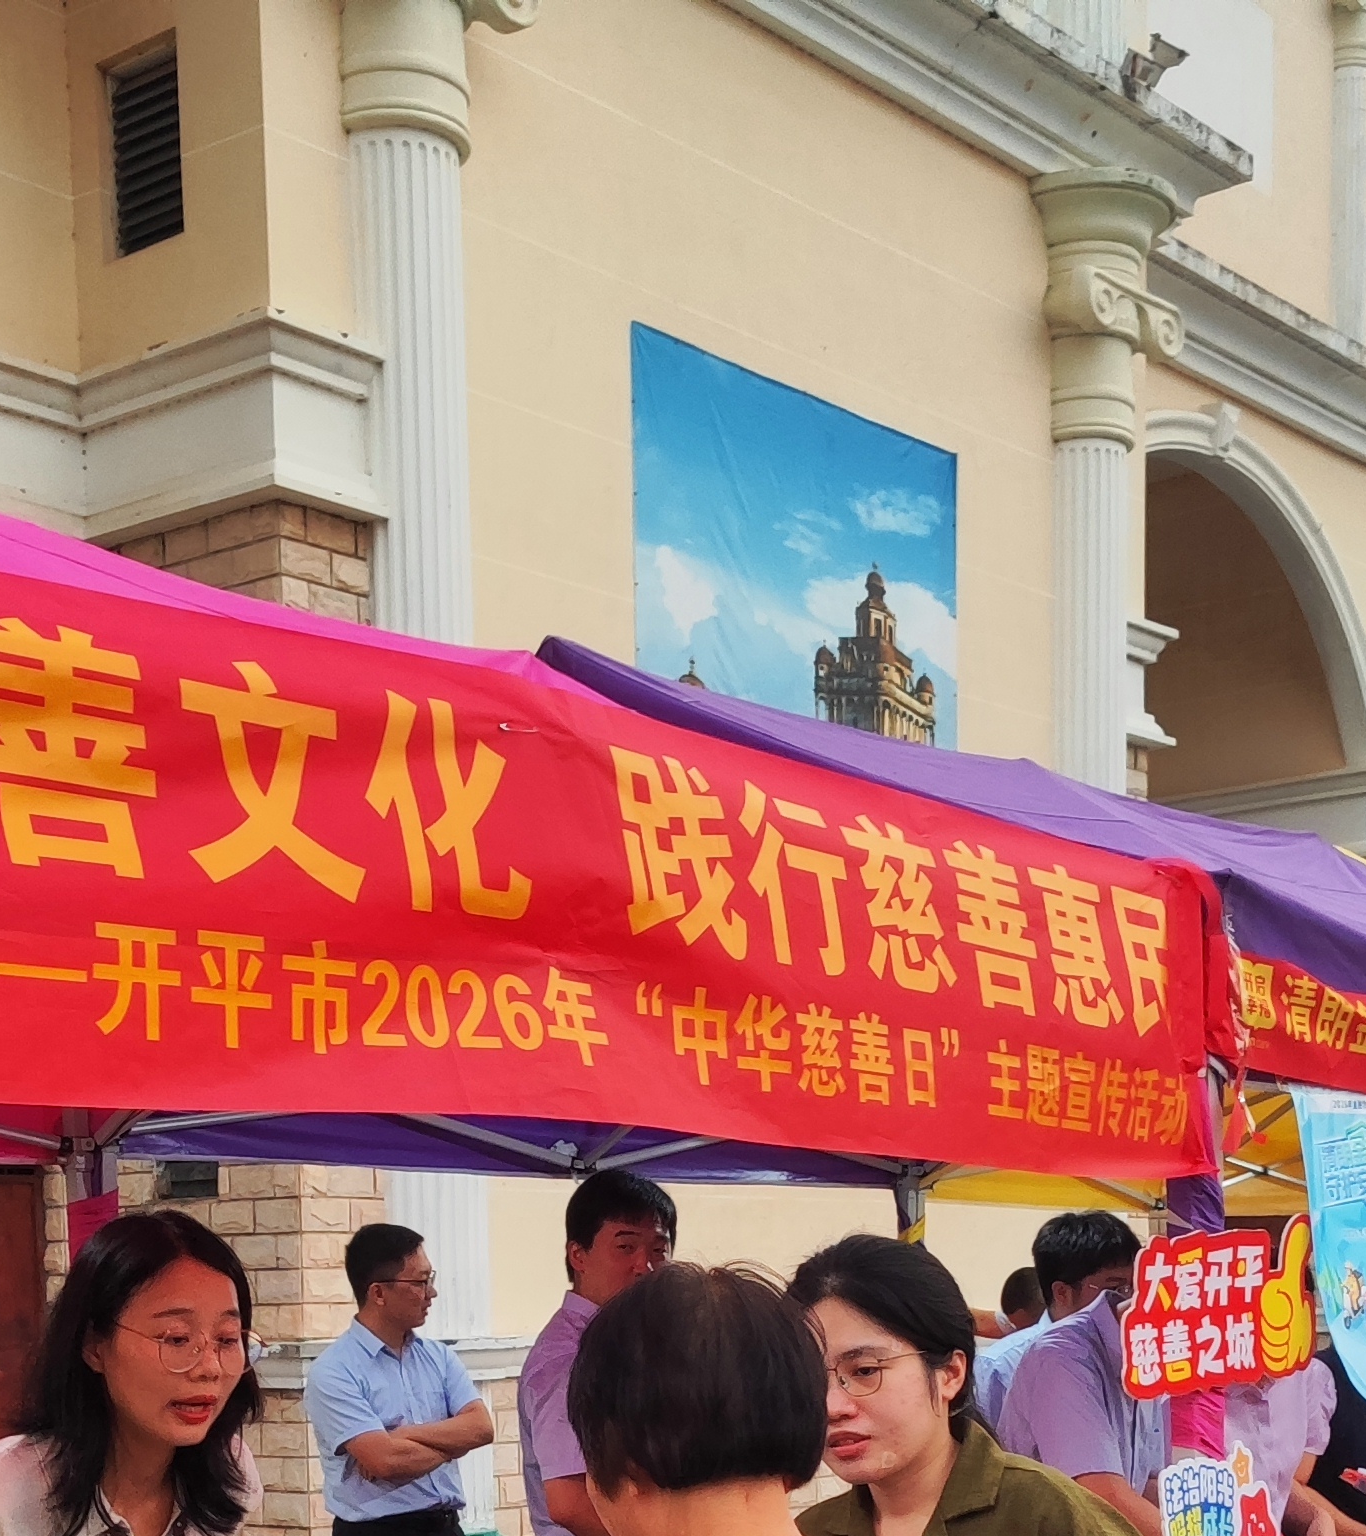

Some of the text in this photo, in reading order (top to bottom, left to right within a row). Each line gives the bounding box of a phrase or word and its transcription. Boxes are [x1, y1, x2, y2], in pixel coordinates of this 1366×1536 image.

[609, 744, 1169, 1039] 践行慈善惠民
[635, 980, 960, 1107] “中华慈善日”
[986, 1040, 1189, 1147] 主题宣传活动
[1143, 1243, 1266, 1315] 大爱开平
[1129, 1312, 1257, 1387] 慈善之城
[1164, 1466, 1236, 1517] 法治阳光
